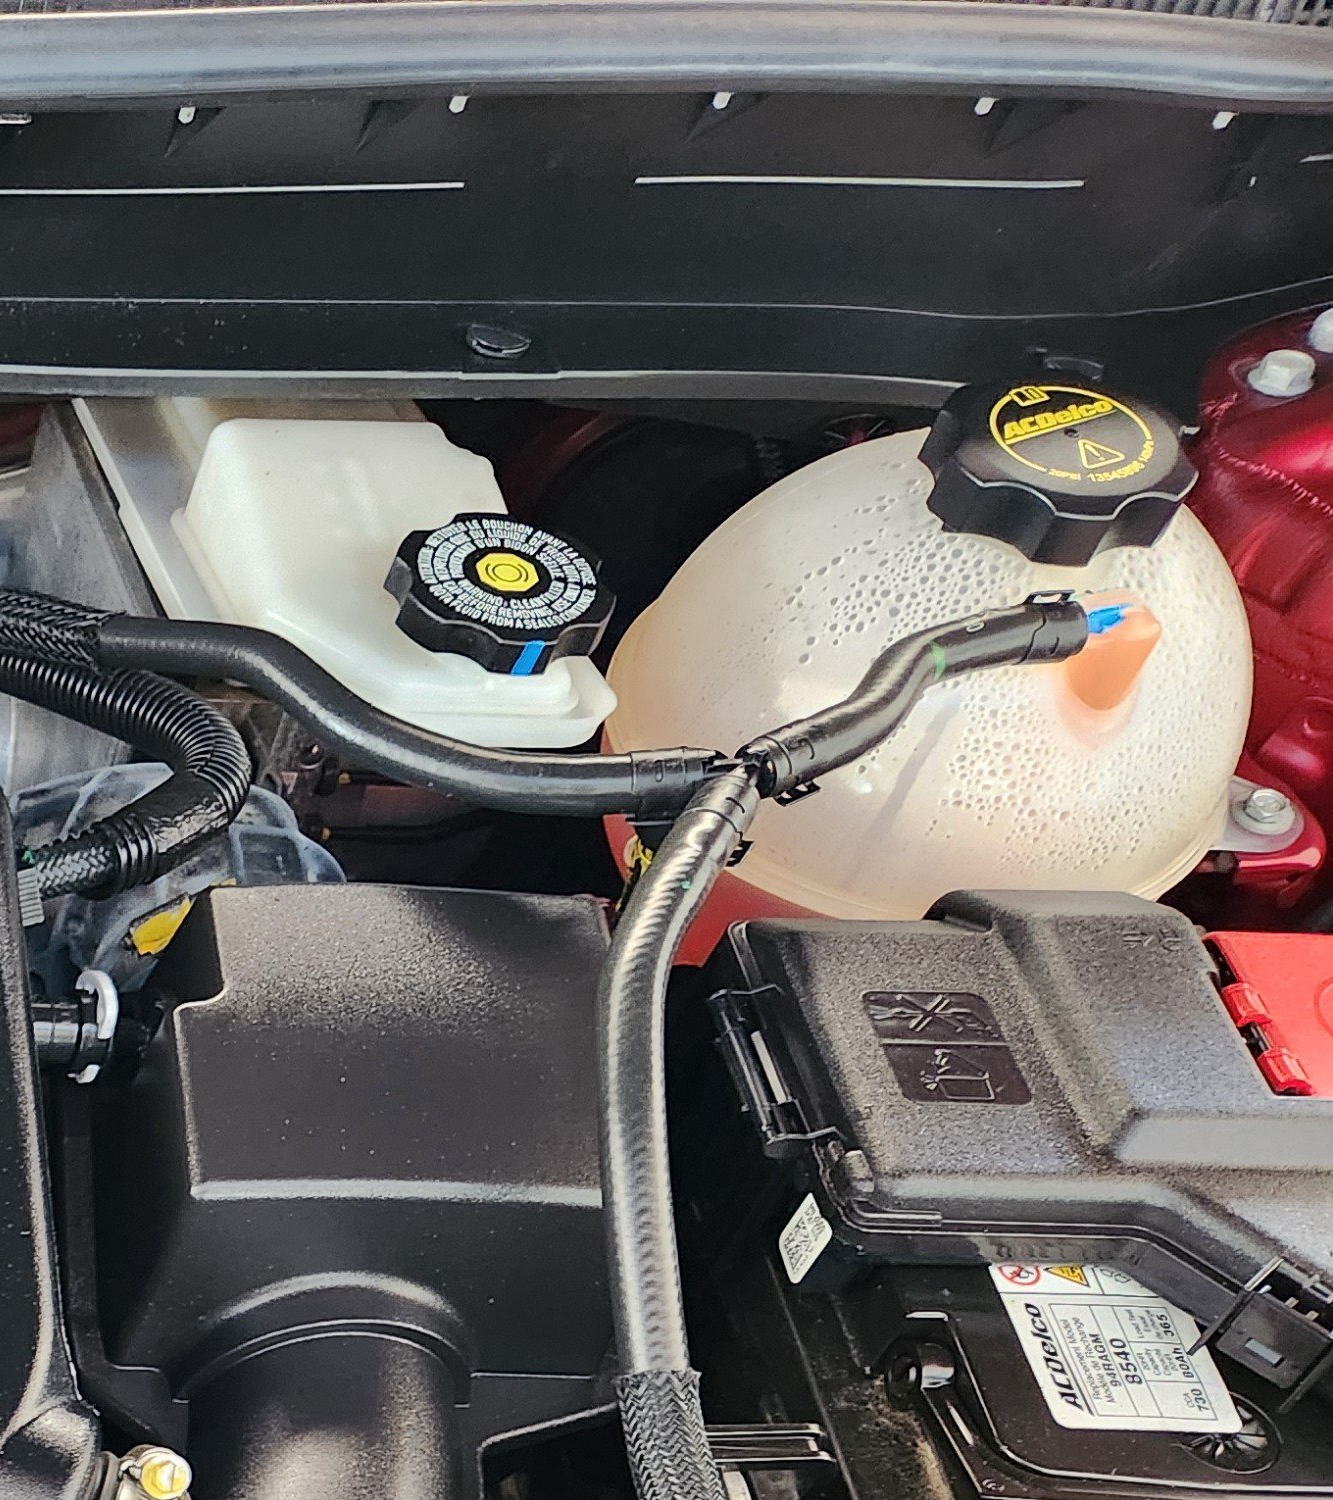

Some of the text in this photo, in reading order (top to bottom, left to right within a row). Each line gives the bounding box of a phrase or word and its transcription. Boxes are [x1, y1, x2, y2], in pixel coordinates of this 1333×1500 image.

[1004, 400, 1113, 440] ACDelco
[465, 519, 481, 530] LE
[482, 519, 533, 535] BOUCHON
[533, 530, 568, 550] AVANT
[563, 547, 579, 559] LA
[469, 528, 485, 540] DU
[486, 528, 528, 543] LIQUIDE
[504, 538, 538, 556] BIDON
[442, 580, 464, 596] CAP
[457, 591, 498, 616] BEFORE
[449, 598, 482, 619] FLUID
[481, 612, 514, 628] FROM
[523, 615, 564, 629] SEALED
[1058, 1319, 1078, 1343] Model
[1155, 1314, 1175, 1336] 365
[1024, 1302, 1084, 1411] ACDelco
[1087, 1333, 1123, 1386] 94RAGM
[1106, 1337, 1144, 1384] 8540
[1189, 1388, 1211, 1411] 730
